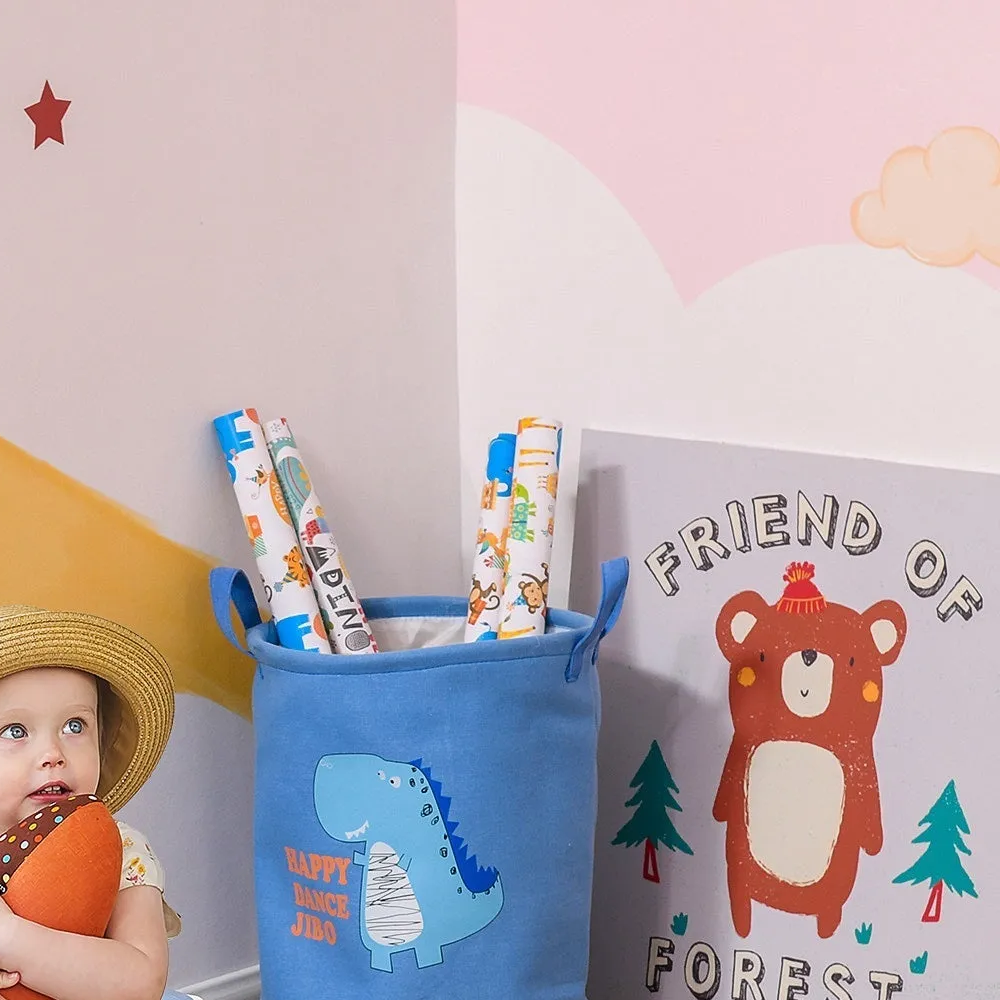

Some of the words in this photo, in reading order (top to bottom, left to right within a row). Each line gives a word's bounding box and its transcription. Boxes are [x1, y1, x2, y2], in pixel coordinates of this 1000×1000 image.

[644, 490, 882, 597] FRIEND
[904, 539, 983, 623] OF
[284, 846, 351, 885] HAPPY
[293, 882, 350, 919] DANCE
[291, 912, 337, 945] JIBO
